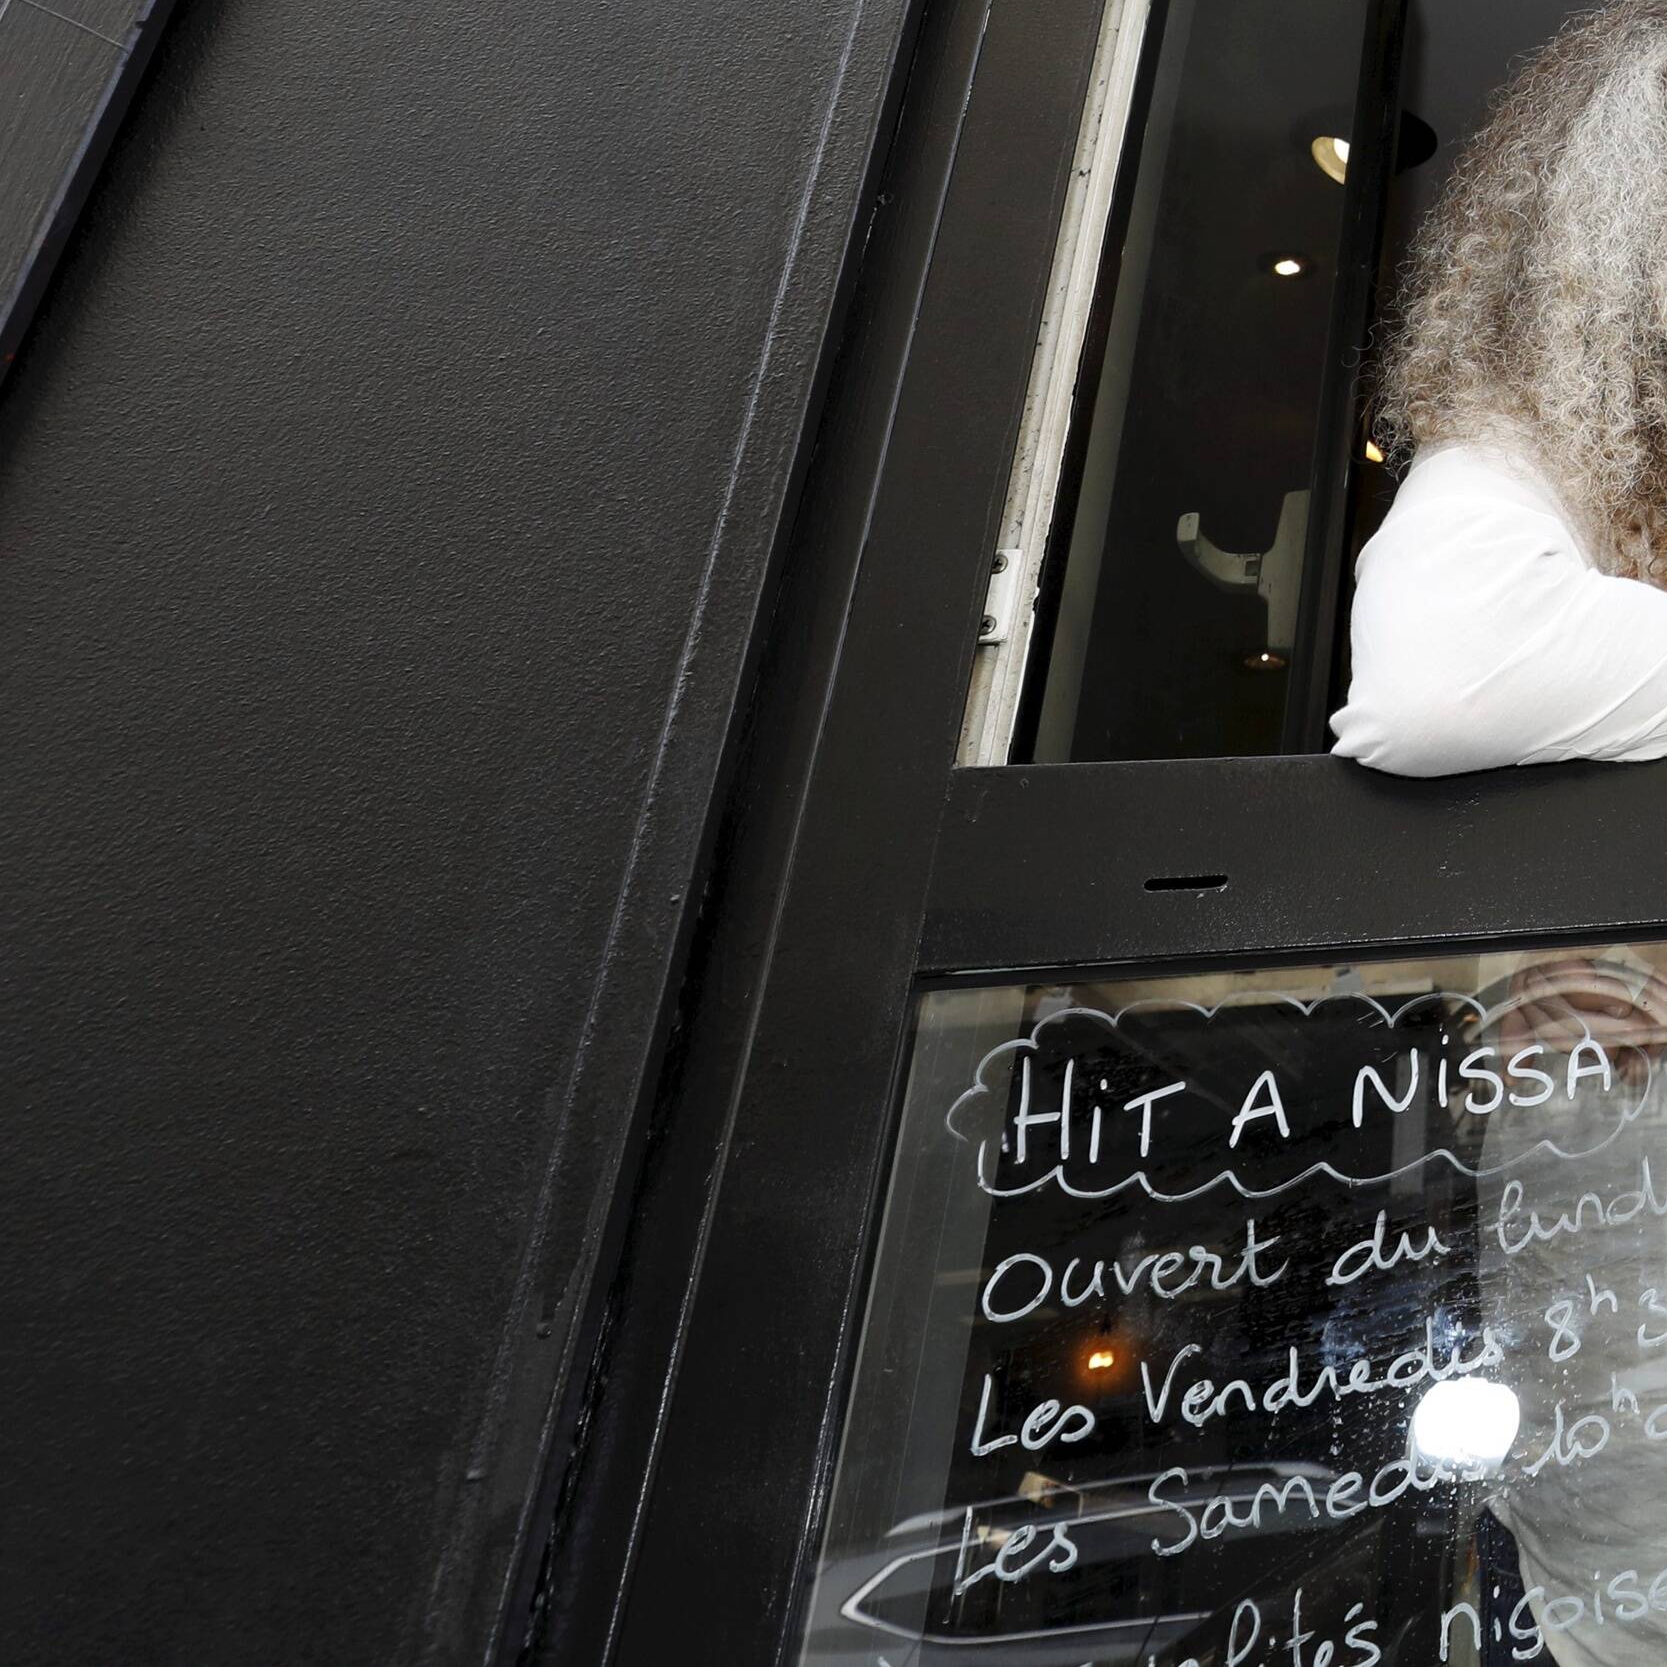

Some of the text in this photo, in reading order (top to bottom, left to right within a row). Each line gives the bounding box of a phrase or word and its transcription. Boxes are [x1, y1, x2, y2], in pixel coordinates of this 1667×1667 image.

[1228, 1069, 1290, 1149] A
[981, 1217, 1285, 1323] Ouvert
[1326, 1209, 1450, 1286] du
[969, 1372, 1095, 1458] Les
[943, 1506, 1081, 1625] Les
